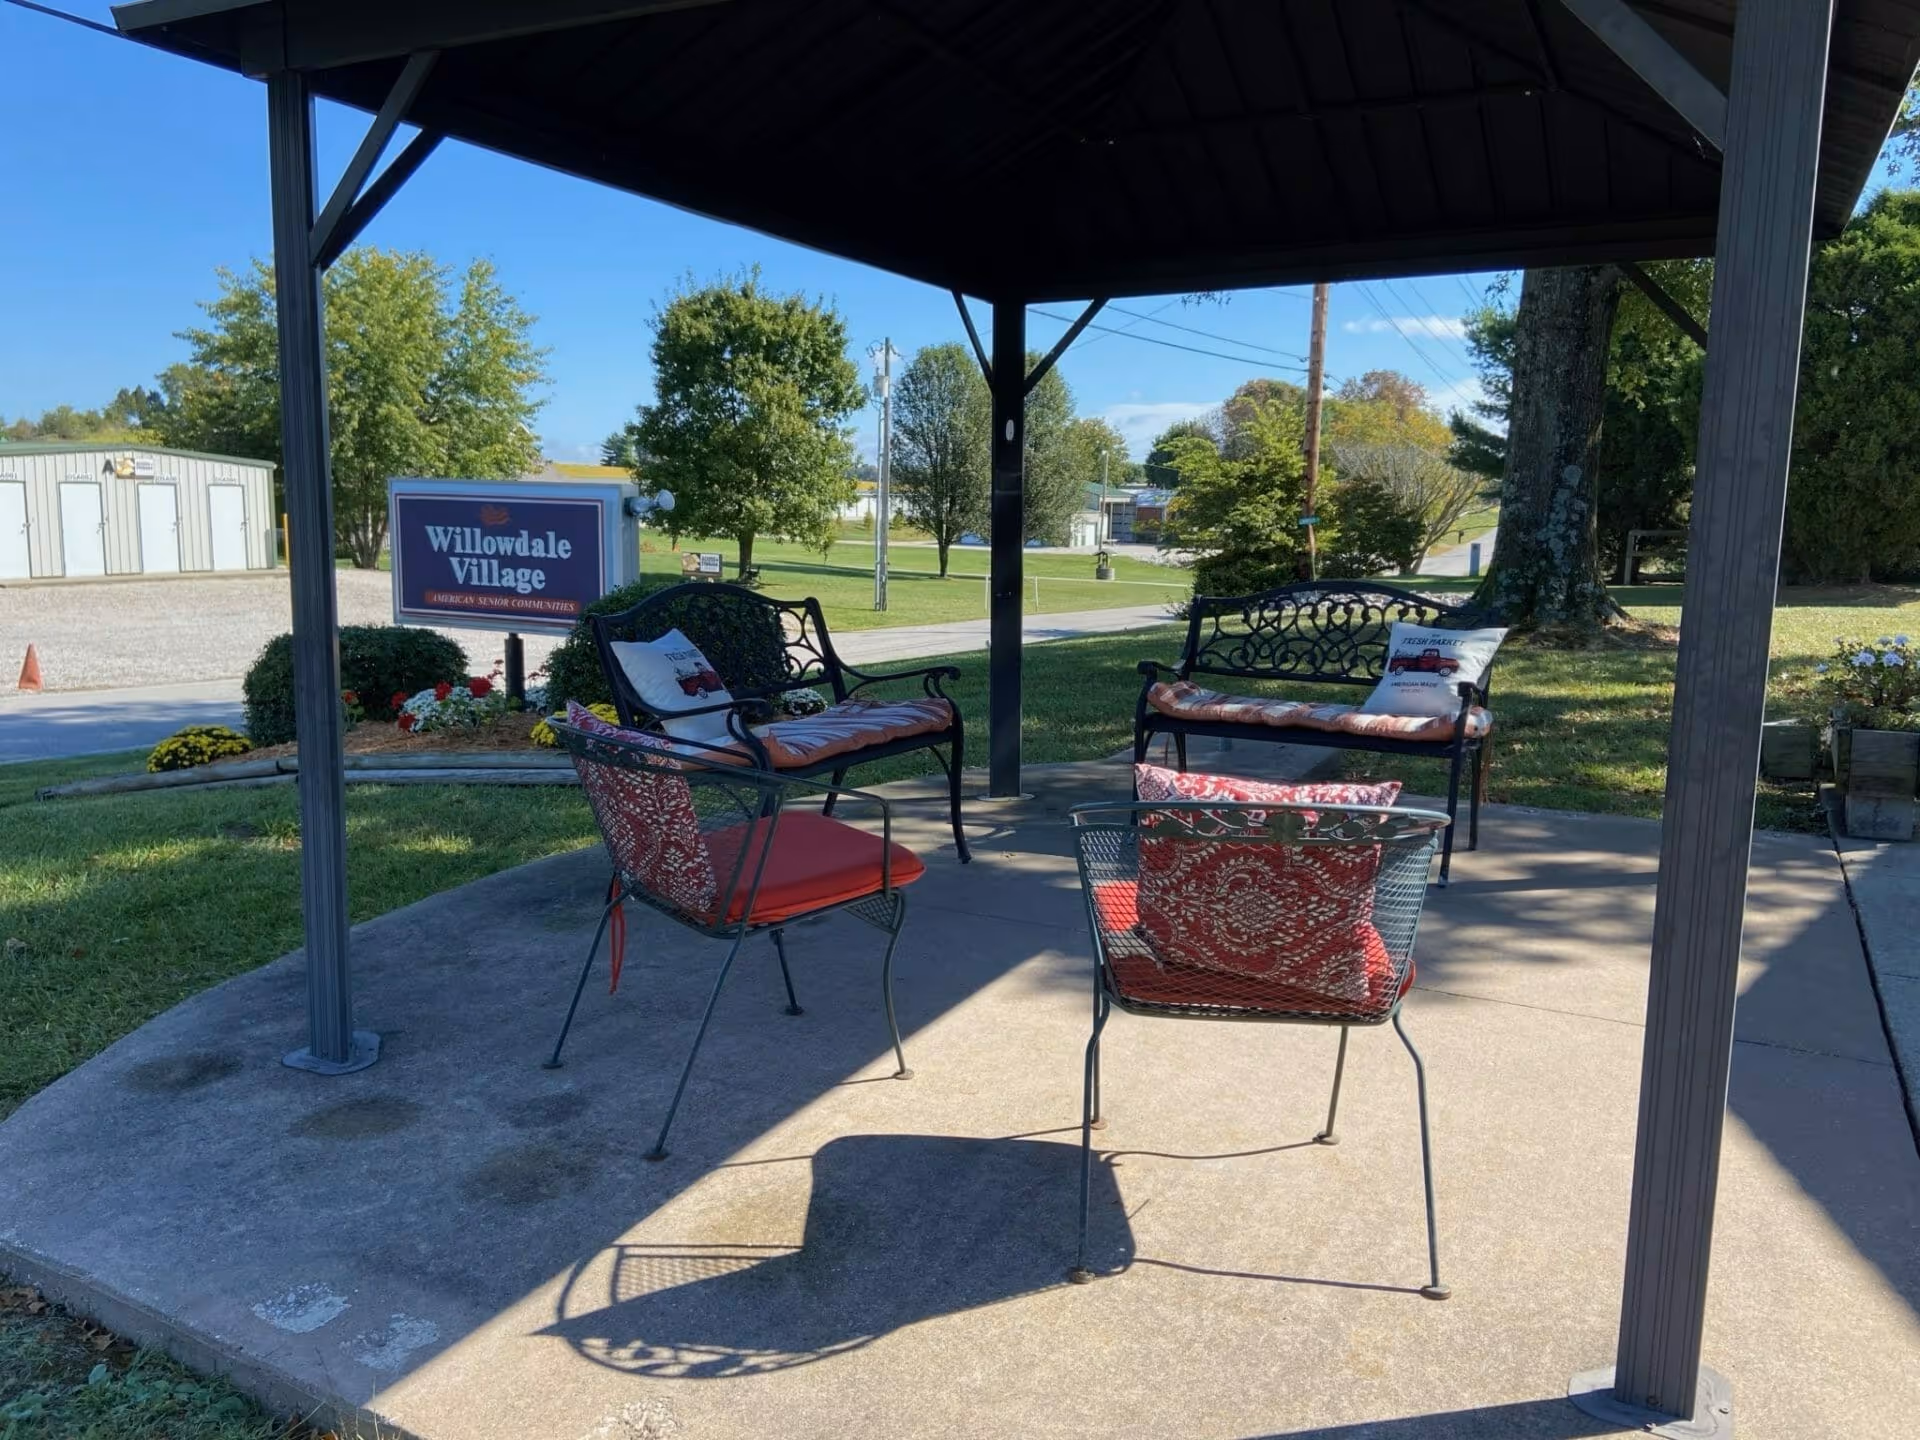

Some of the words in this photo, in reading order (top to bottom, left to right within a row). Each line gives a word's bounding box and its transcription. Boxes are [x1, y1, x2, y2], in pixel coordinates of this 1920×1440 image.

[425, 525, 571, 559] Willowdale
[449, 557, 546, 594] Village
[433, 595, 475, 604] AMERICAN
[477, 596, 509, 607] SENIOR
[512, 599, 575, 611] COMMUNITIES
